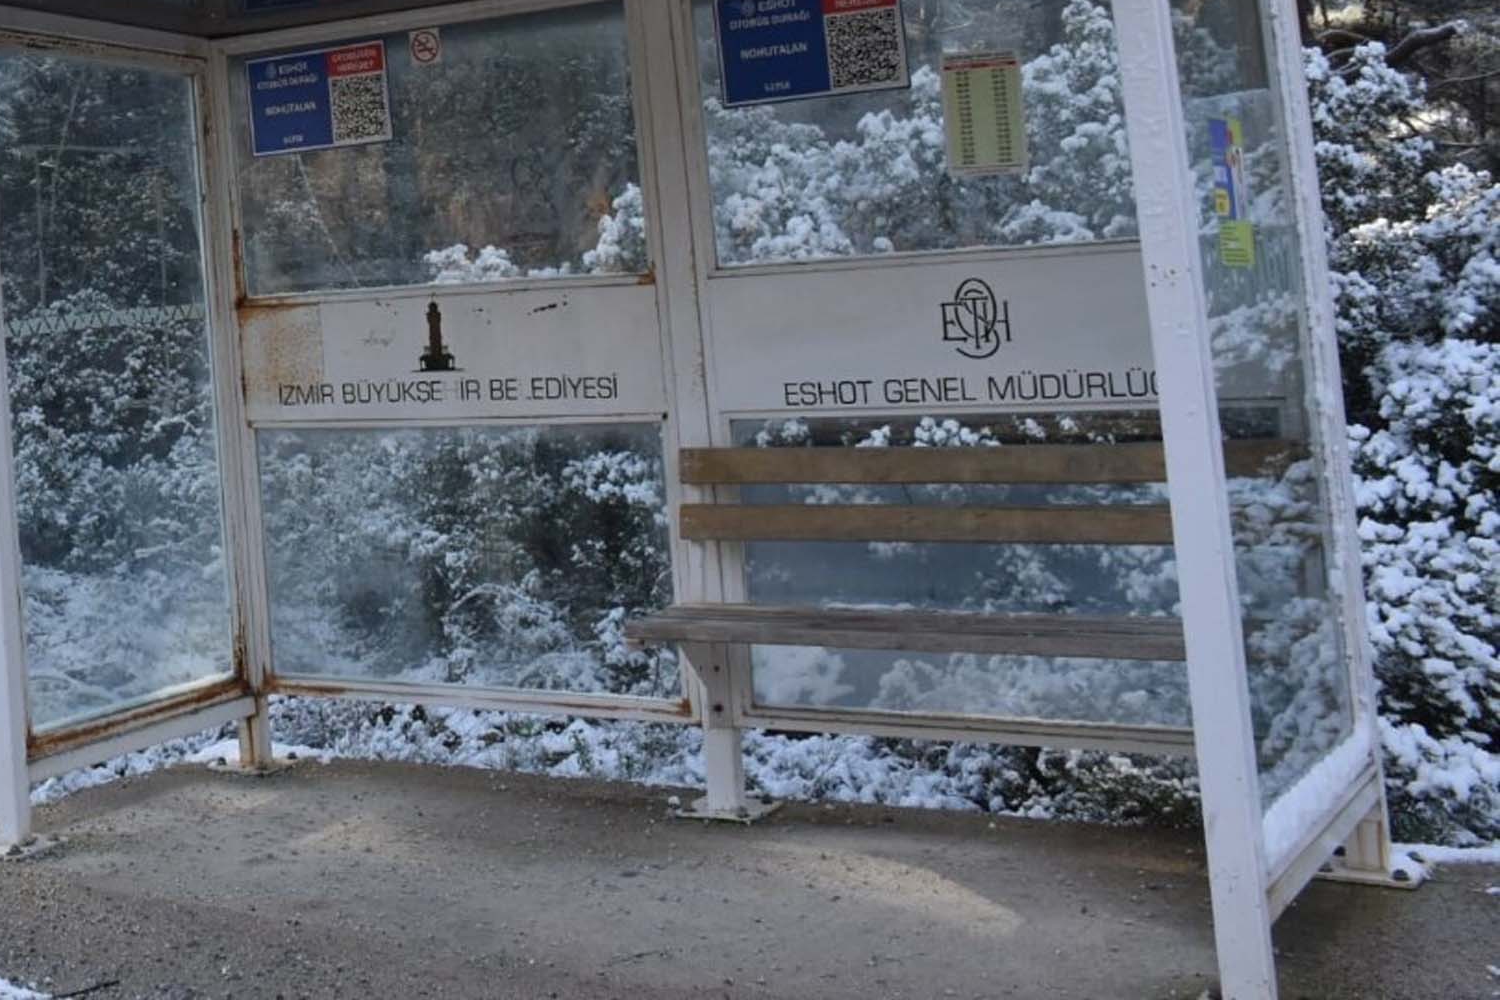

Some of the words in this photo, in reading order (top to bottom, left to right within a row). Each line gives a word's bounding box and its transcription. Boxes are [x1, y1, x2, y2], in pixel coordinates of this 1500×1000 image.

[739, 41, 809, 60] NOHUTALAN
[489, 372, 619, 401] BEEDİYESİ
[783, 380, 873, 407] ESHOT
[883, 376, 977, 404] GENEL
